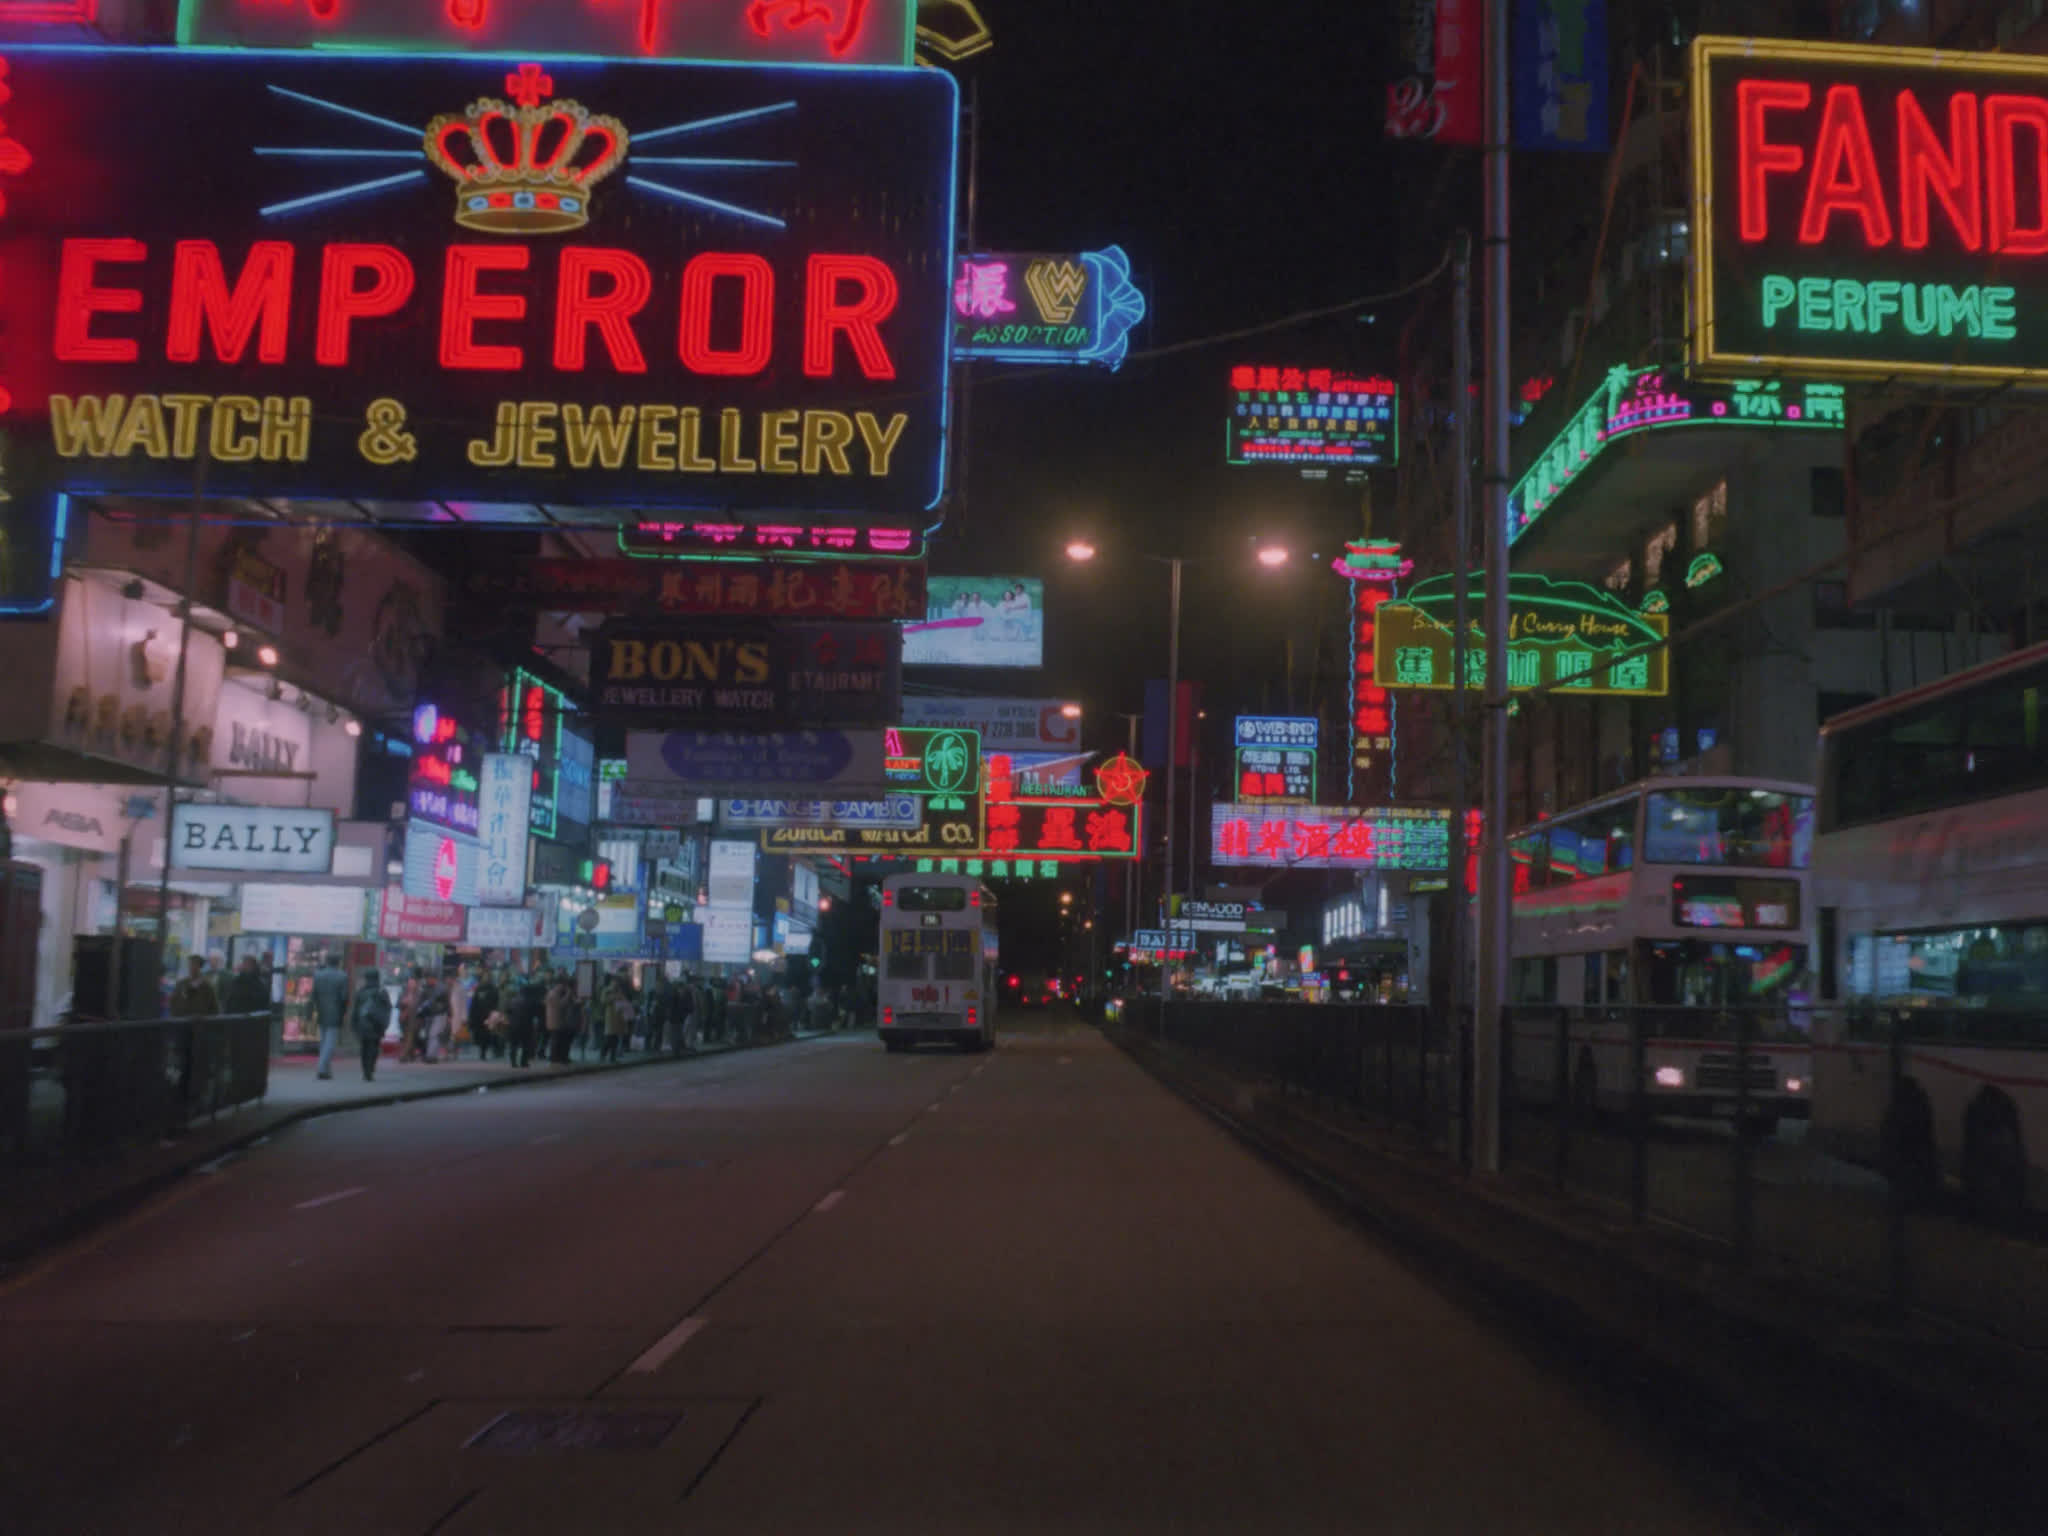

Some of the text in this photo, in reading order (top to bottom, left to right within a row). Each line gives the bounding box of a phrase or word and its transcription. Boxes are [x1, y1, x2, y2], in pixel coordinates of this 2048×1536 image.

[1737, 79, 2048, 253] FAND
[54, 237, 898, 380] EMPEROR
[1762, 275, 2017, 339] PERFUME
[50, 394, 908, 477] WATCH & JEWELLERY
[1523, 612, 1575, 638] Curry
[1580, 614, 1630, 636] House
[608, 637, 770, 685] BON'S
[602, 687, 775, 711] JEWELLERY WATCH
[728, 797, 915, 819] CHANGE CAMBIO
[184, 822, 321, 854] BALLY
[942, 821, 975, 843] CO.
